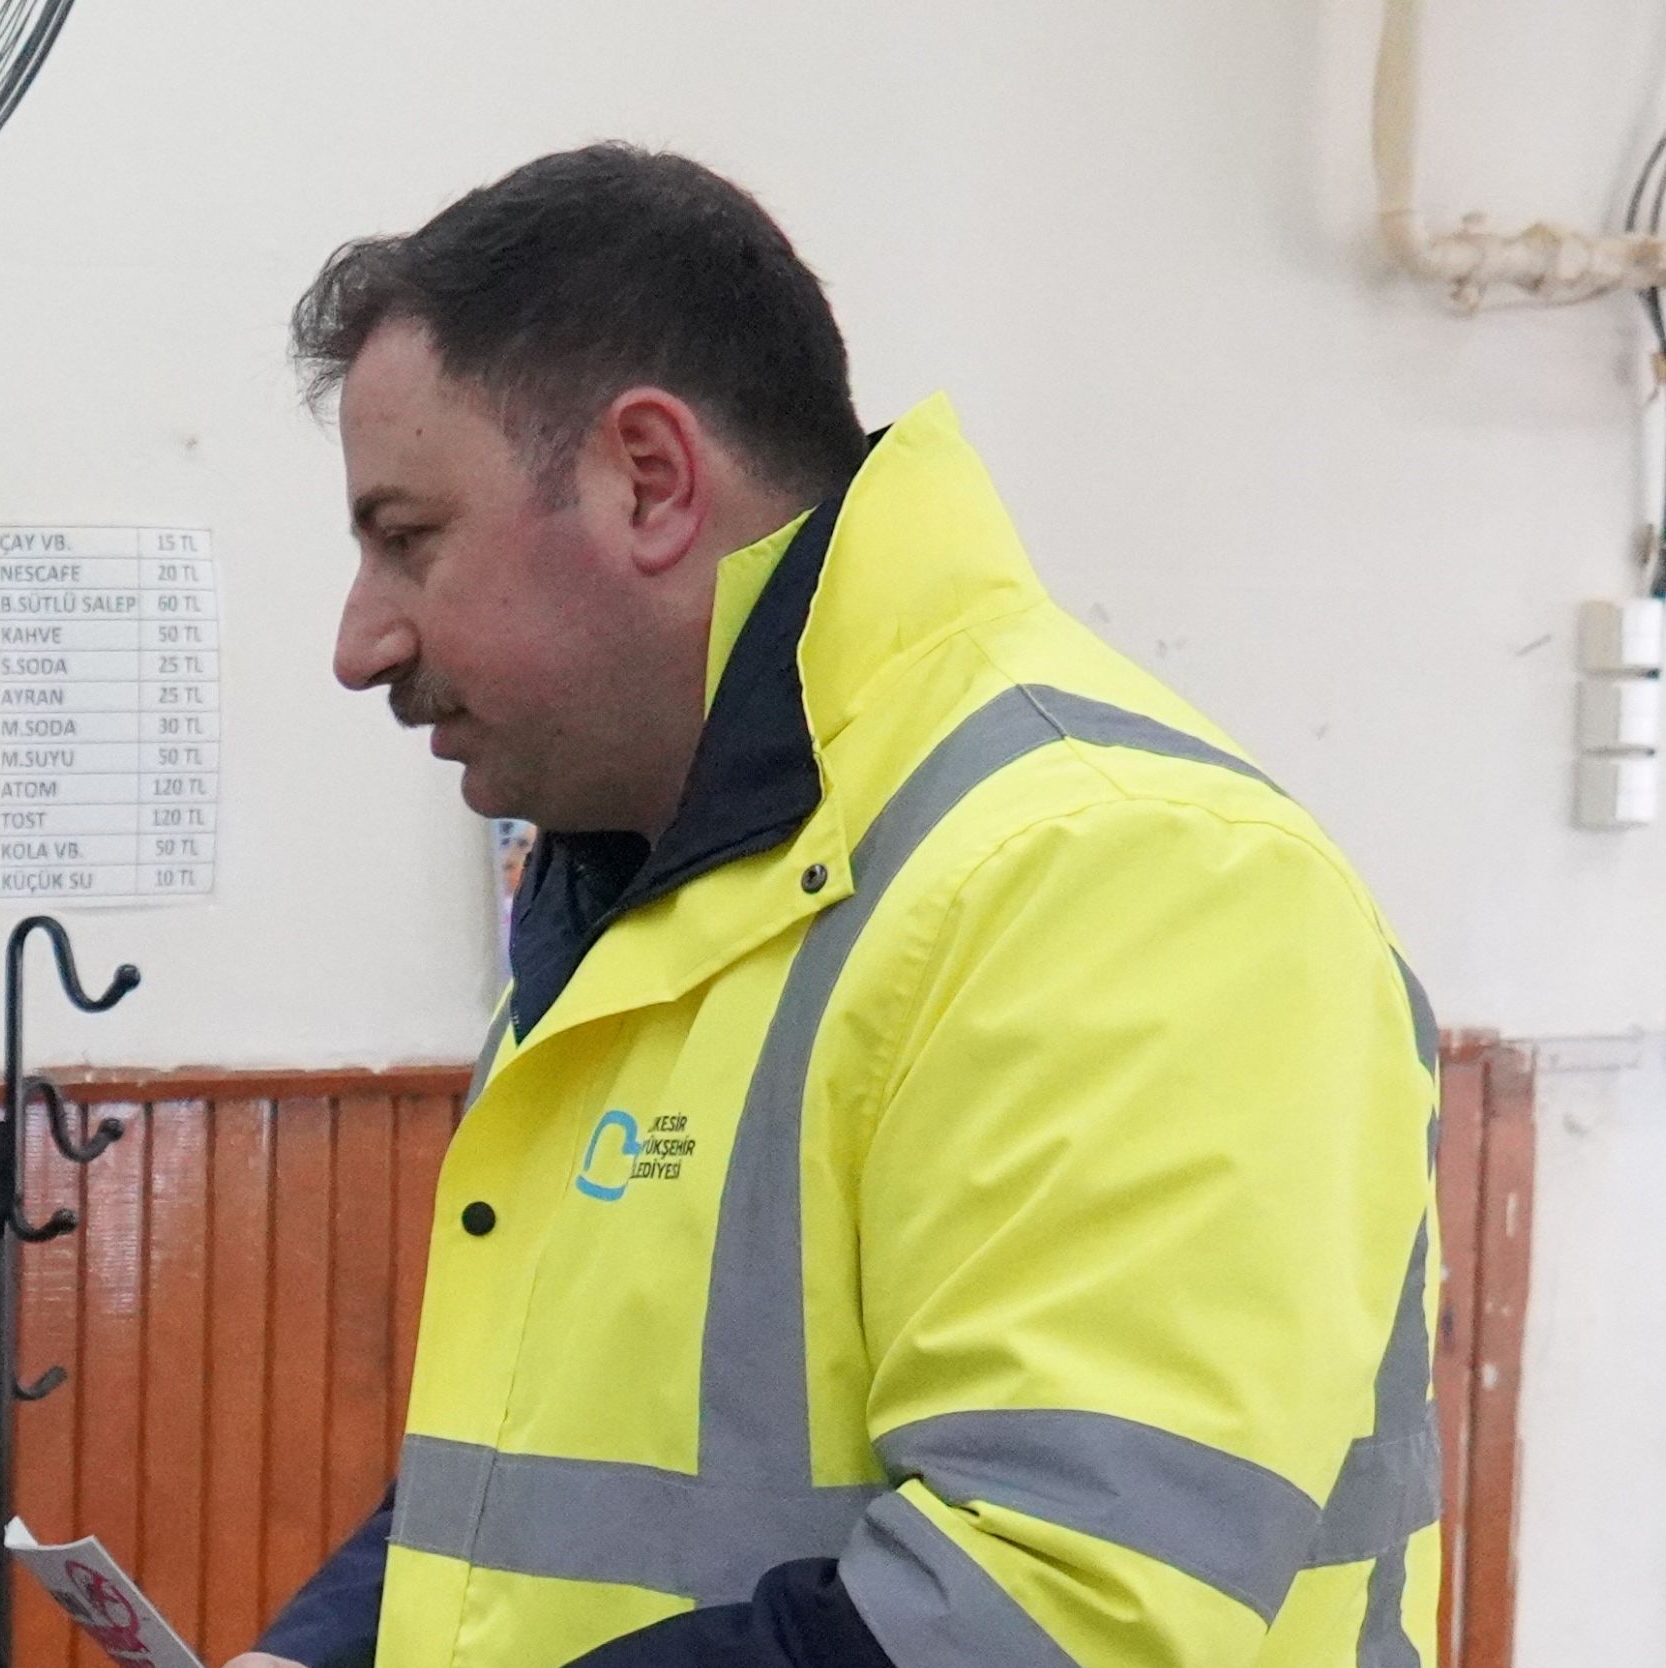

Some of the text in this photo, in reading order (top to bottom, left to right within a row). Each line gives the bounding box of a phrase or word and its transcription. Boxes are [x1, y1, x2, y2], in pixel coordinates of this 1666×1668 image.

[0, 534, 198, 555] ÇAY VB. 15 TL
[0, 565, 199, 582] NESCAFE 20 TL
[0, 592, 76, 614] B.SÜTLÜ
[82, 596, 137, 613] SALEP
[184, 596, 201, 612] TL
[1, 626, 203, 645] KAHVE 50 TL
[1, 657, 204, 675] S.SODA 25 TL
[1, 687, 203, 706] AYRAN 25 TL
[1, 717, 203, 737] M.SODA 30 TL
[1, 748, 203, 768] M.SUYU 50 TL
[1, 778, 206, 798] ATOM 120 TL
[1, 808, 205, 829] TOST 120 TL
[1, 843, 48, 860] KOLA
[155, 840, 175, 856] 50
[181, 839, 198, 856] TL
[1, 870, 196, 893] KÜÇÜK SU 10 TL
